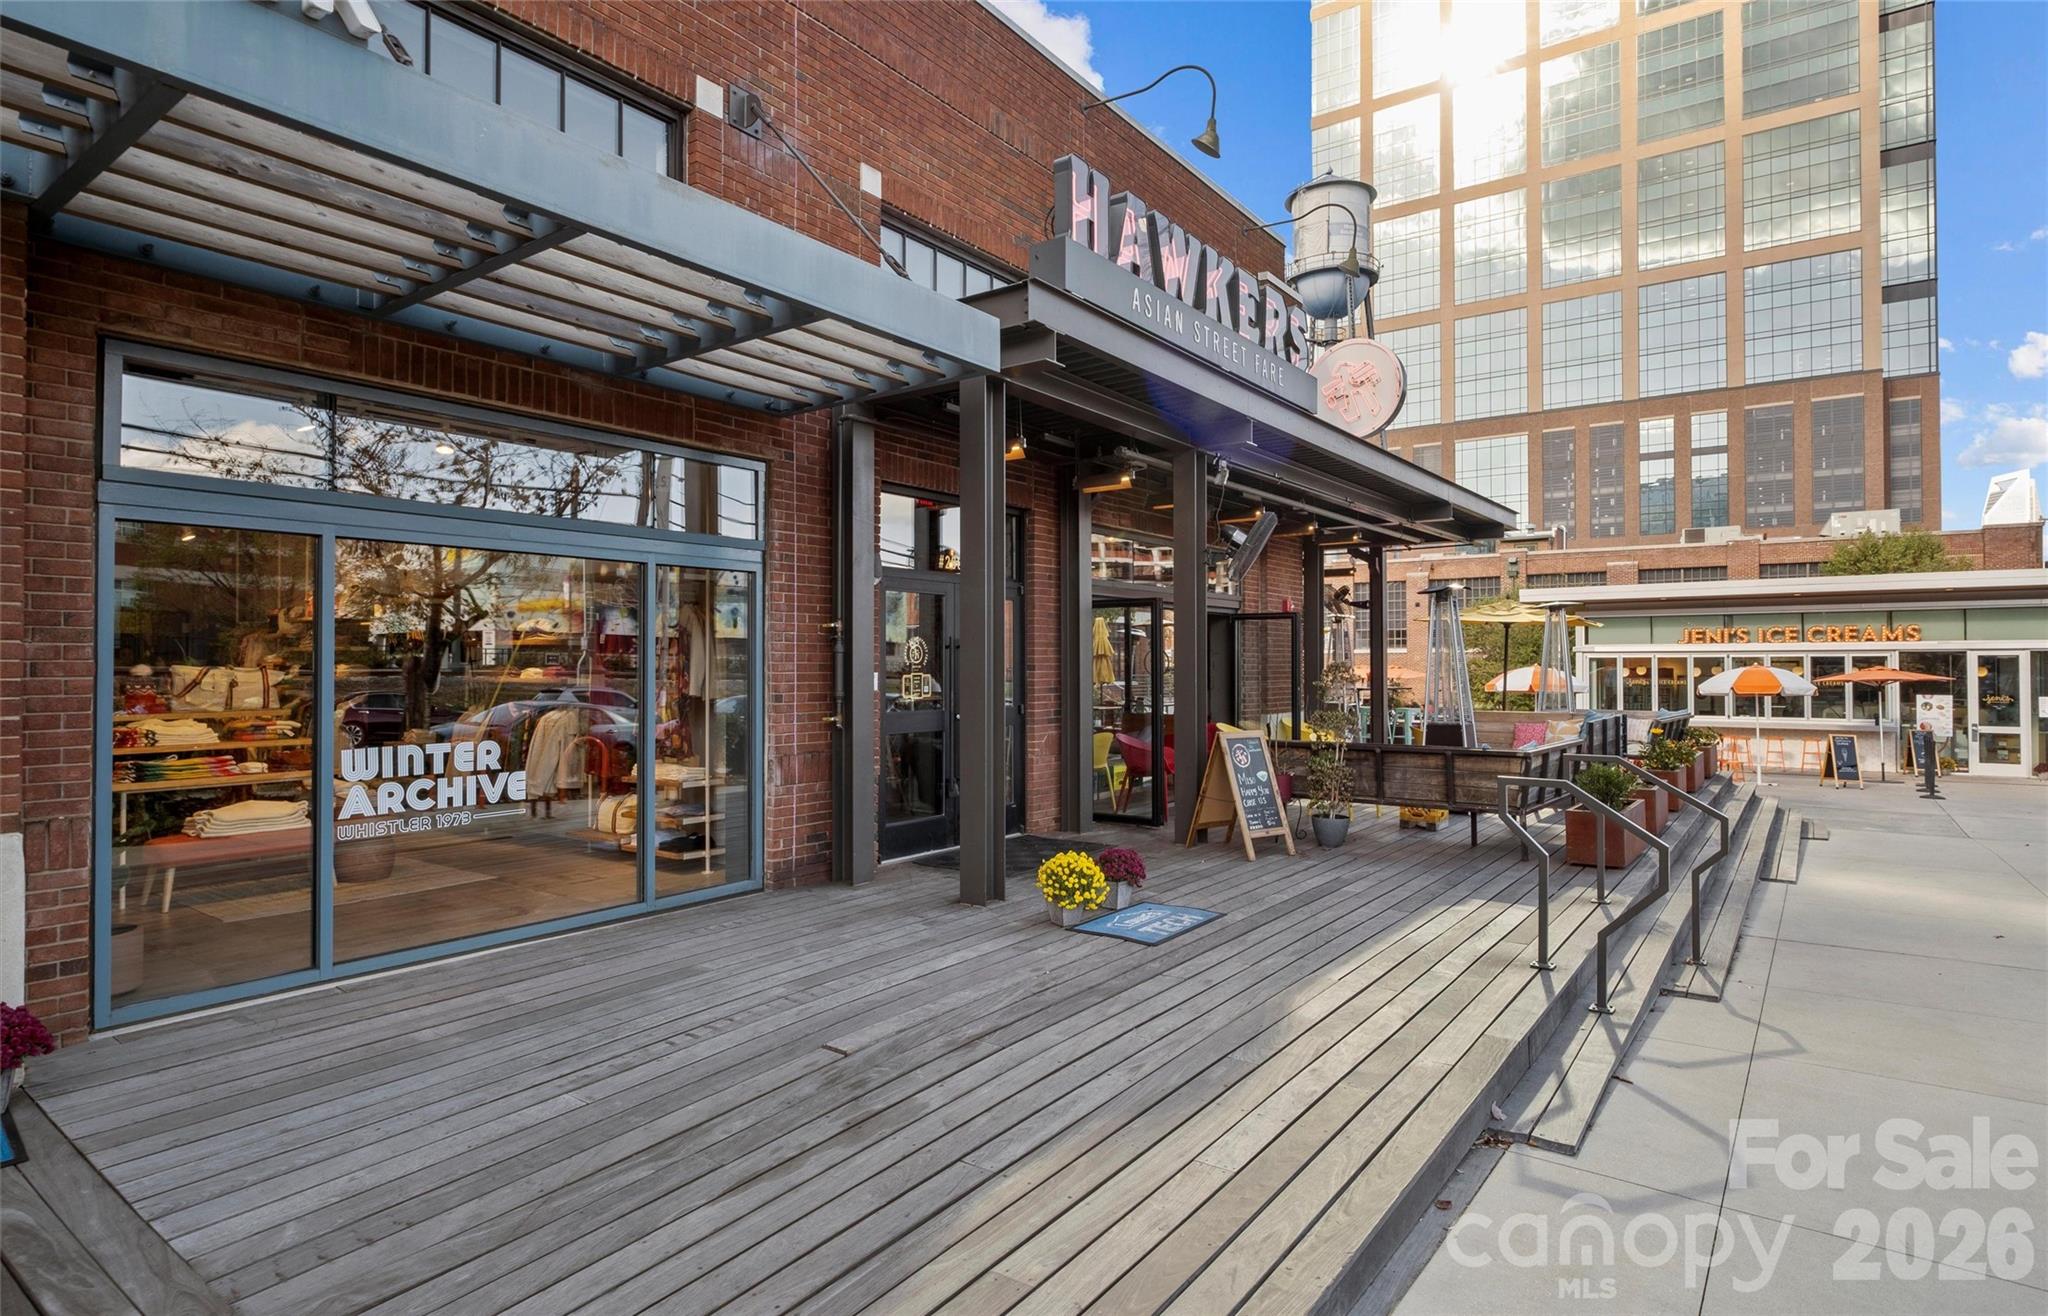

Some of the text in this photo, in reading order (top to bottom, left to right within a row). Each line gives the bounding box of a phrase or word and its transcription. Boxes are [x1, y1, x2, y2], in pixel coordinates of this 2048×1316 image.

[1056, 154, 1310, 373] HAWKERS
[1132, 287, 1285, 388] ASIAN STREET FARE
[1678, 624, 1922, 644] JENI'S ICE CREAMS
[341, 740, 501, 782] WINTER
[337, 771, 526, 820] ARCHIVE
[337, 811, 471, 840] WHISTLER 1973
